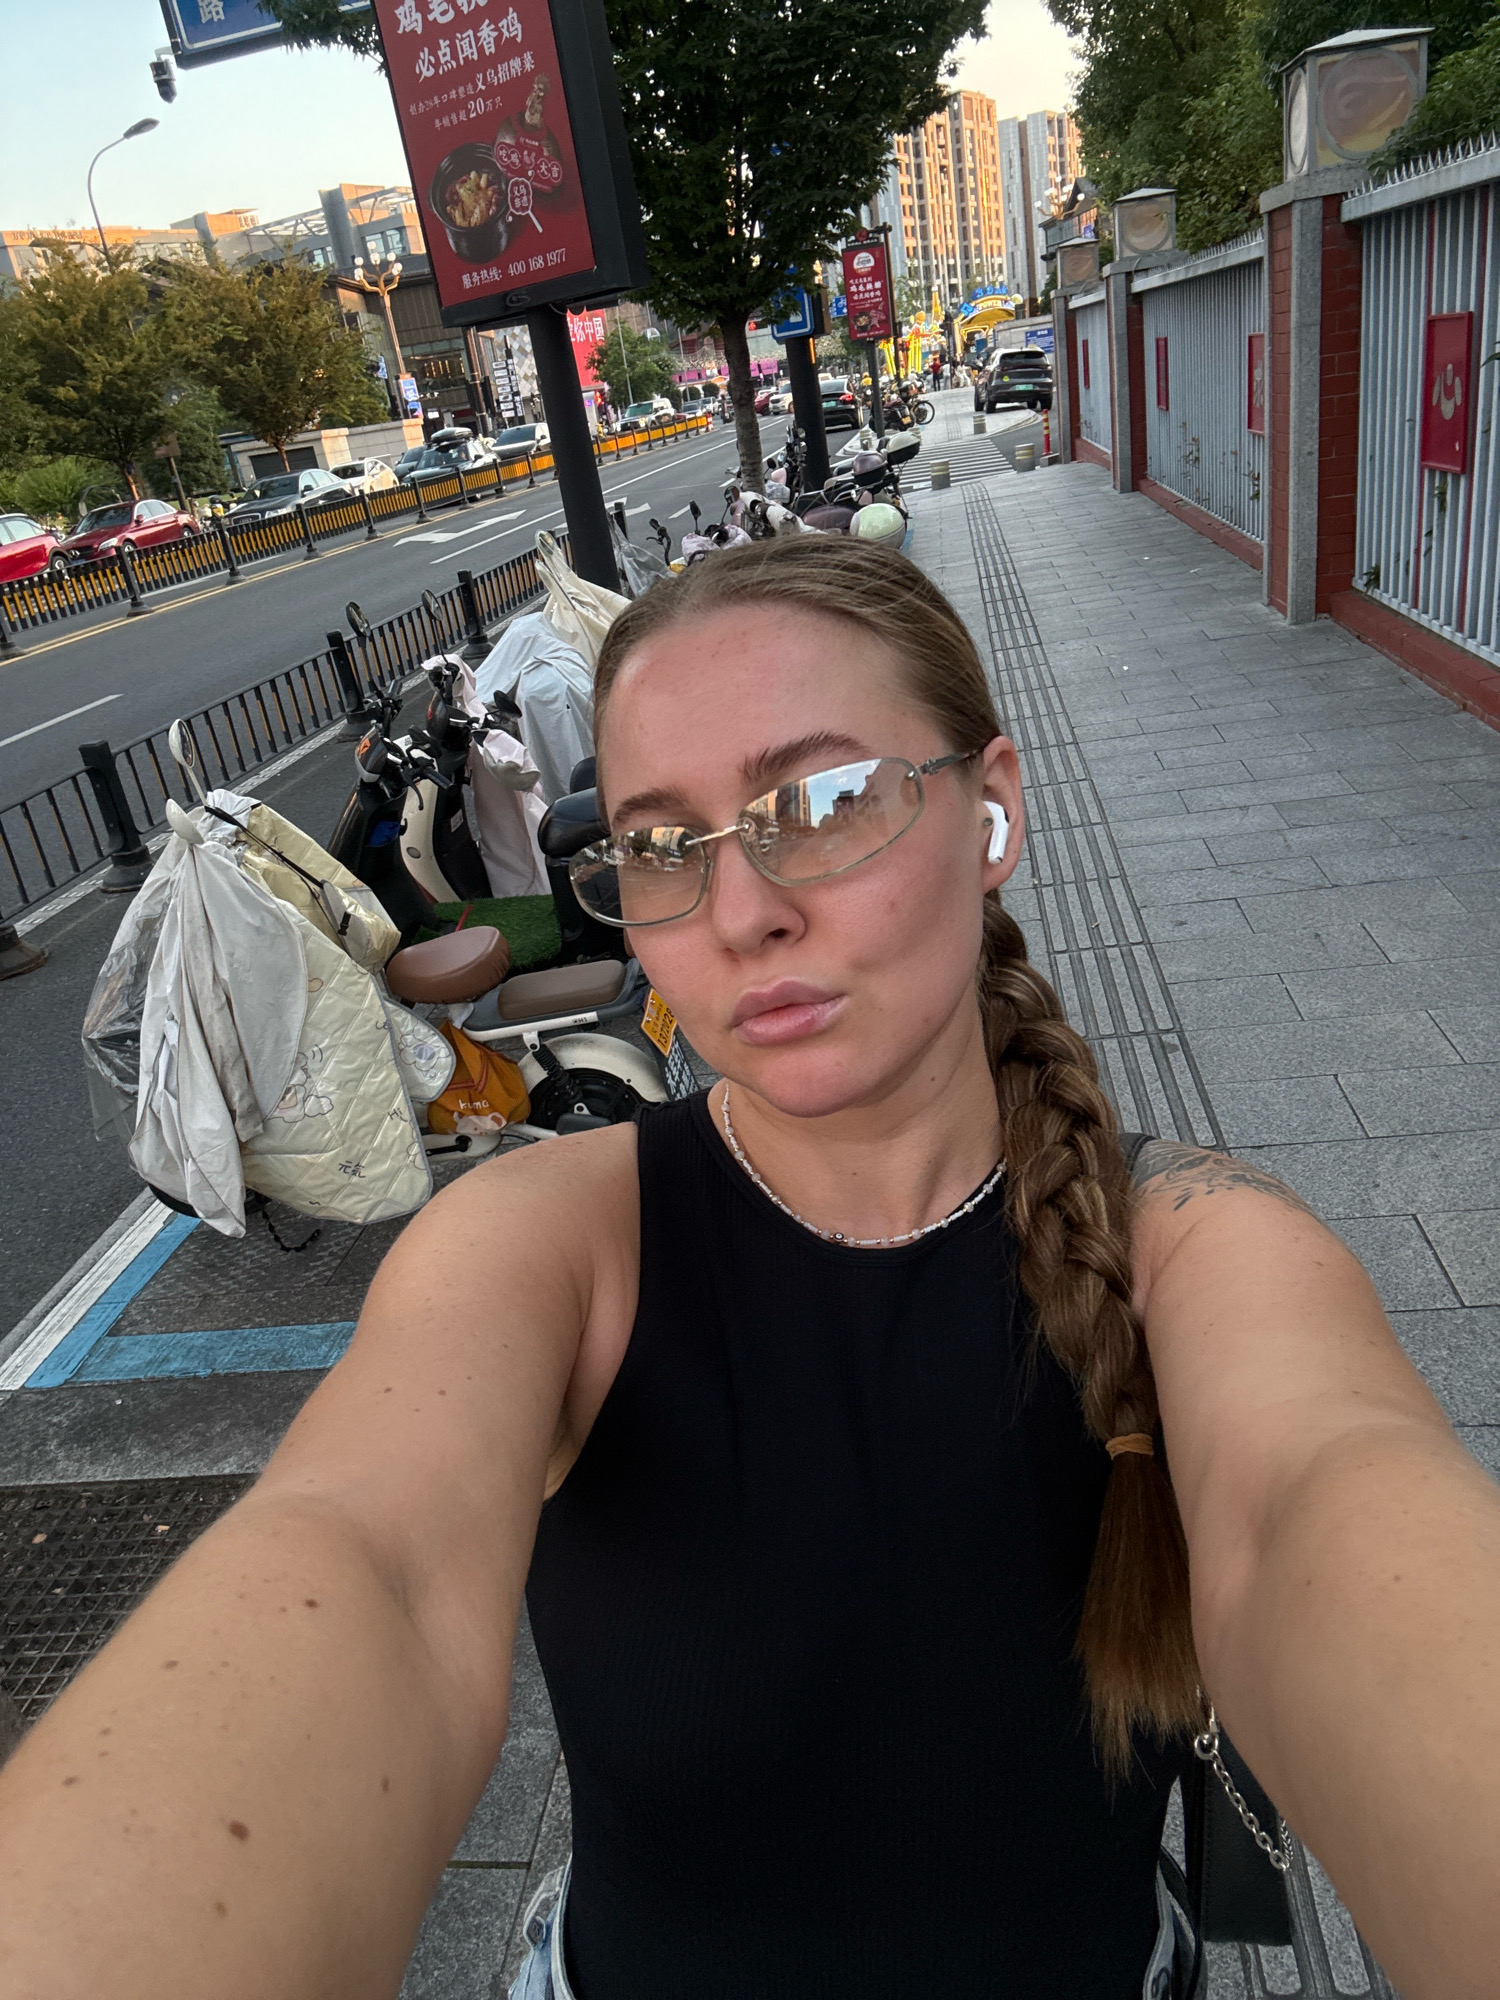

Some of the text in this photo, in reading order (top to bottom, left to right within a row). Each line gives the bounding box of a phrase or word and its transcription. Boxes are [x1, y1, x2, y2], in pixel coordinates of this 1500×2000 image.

[199, 0, 225, 24] 路
[415, 7, 523, 83] 必点闻香鸡
[508, 260, 526, 276] 400
[528, 255, 545, 272] 168
[546, 247, 566, 267] 1977
[338, 1160, 366, 1179] 元気
